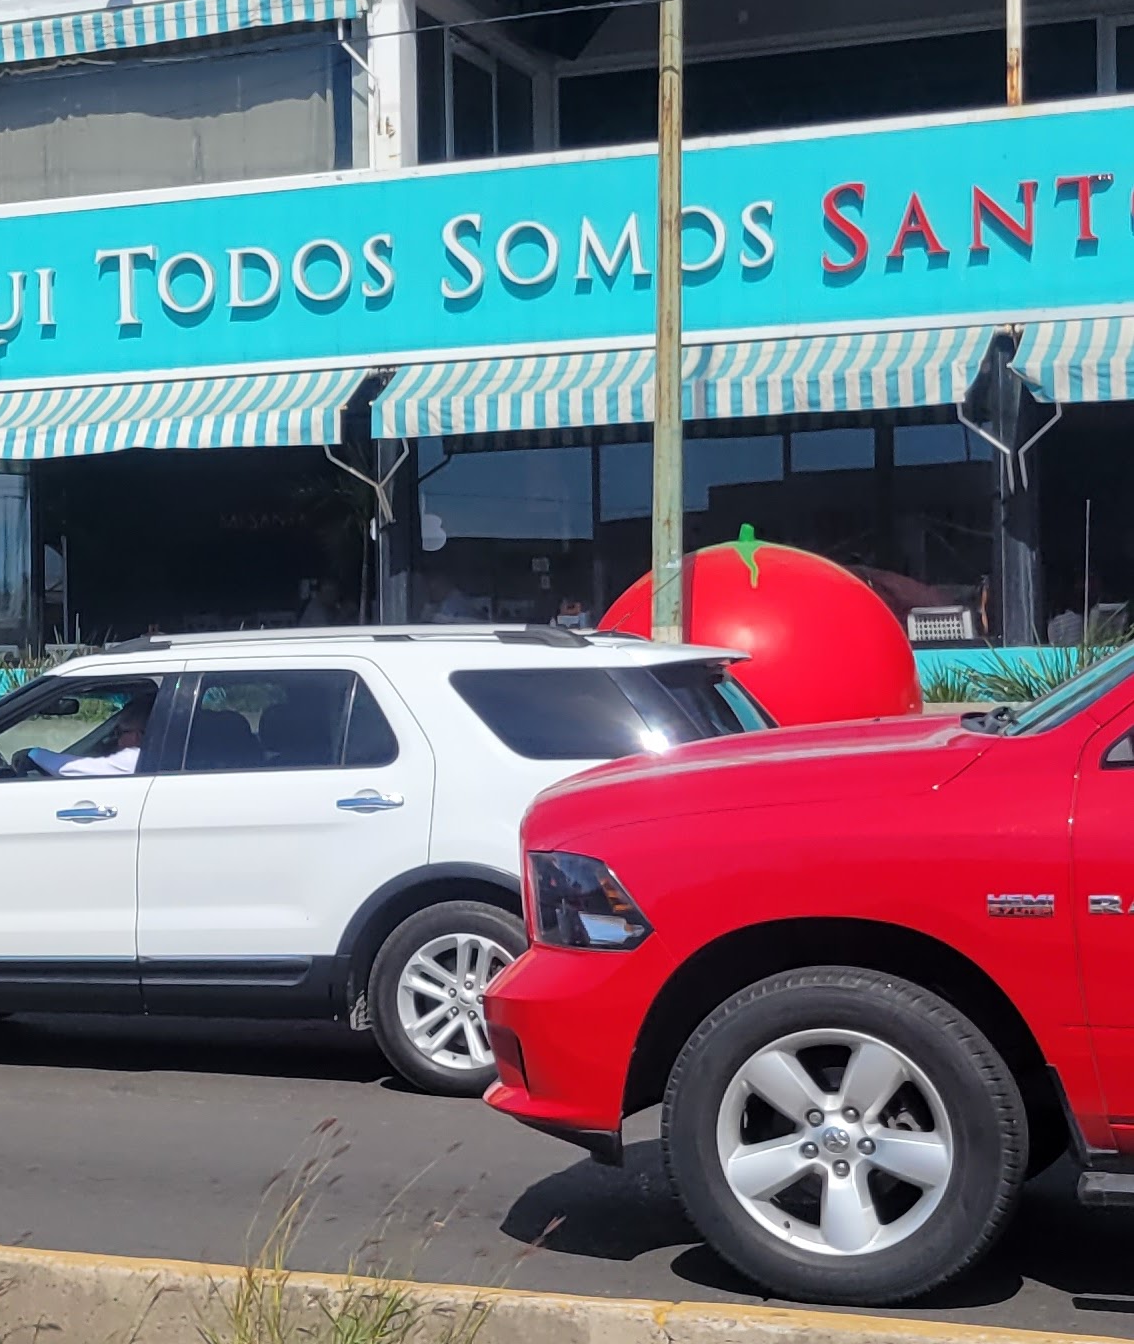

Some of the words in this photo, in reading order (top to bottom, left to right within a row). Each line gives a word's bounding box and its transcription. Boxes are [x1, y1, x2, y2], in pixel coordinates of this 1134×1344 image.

[94, 233, 395, 326] TODOS
[440, 200, 776, 300] SOMOS
[822, 173, 1134, 274] SANT
